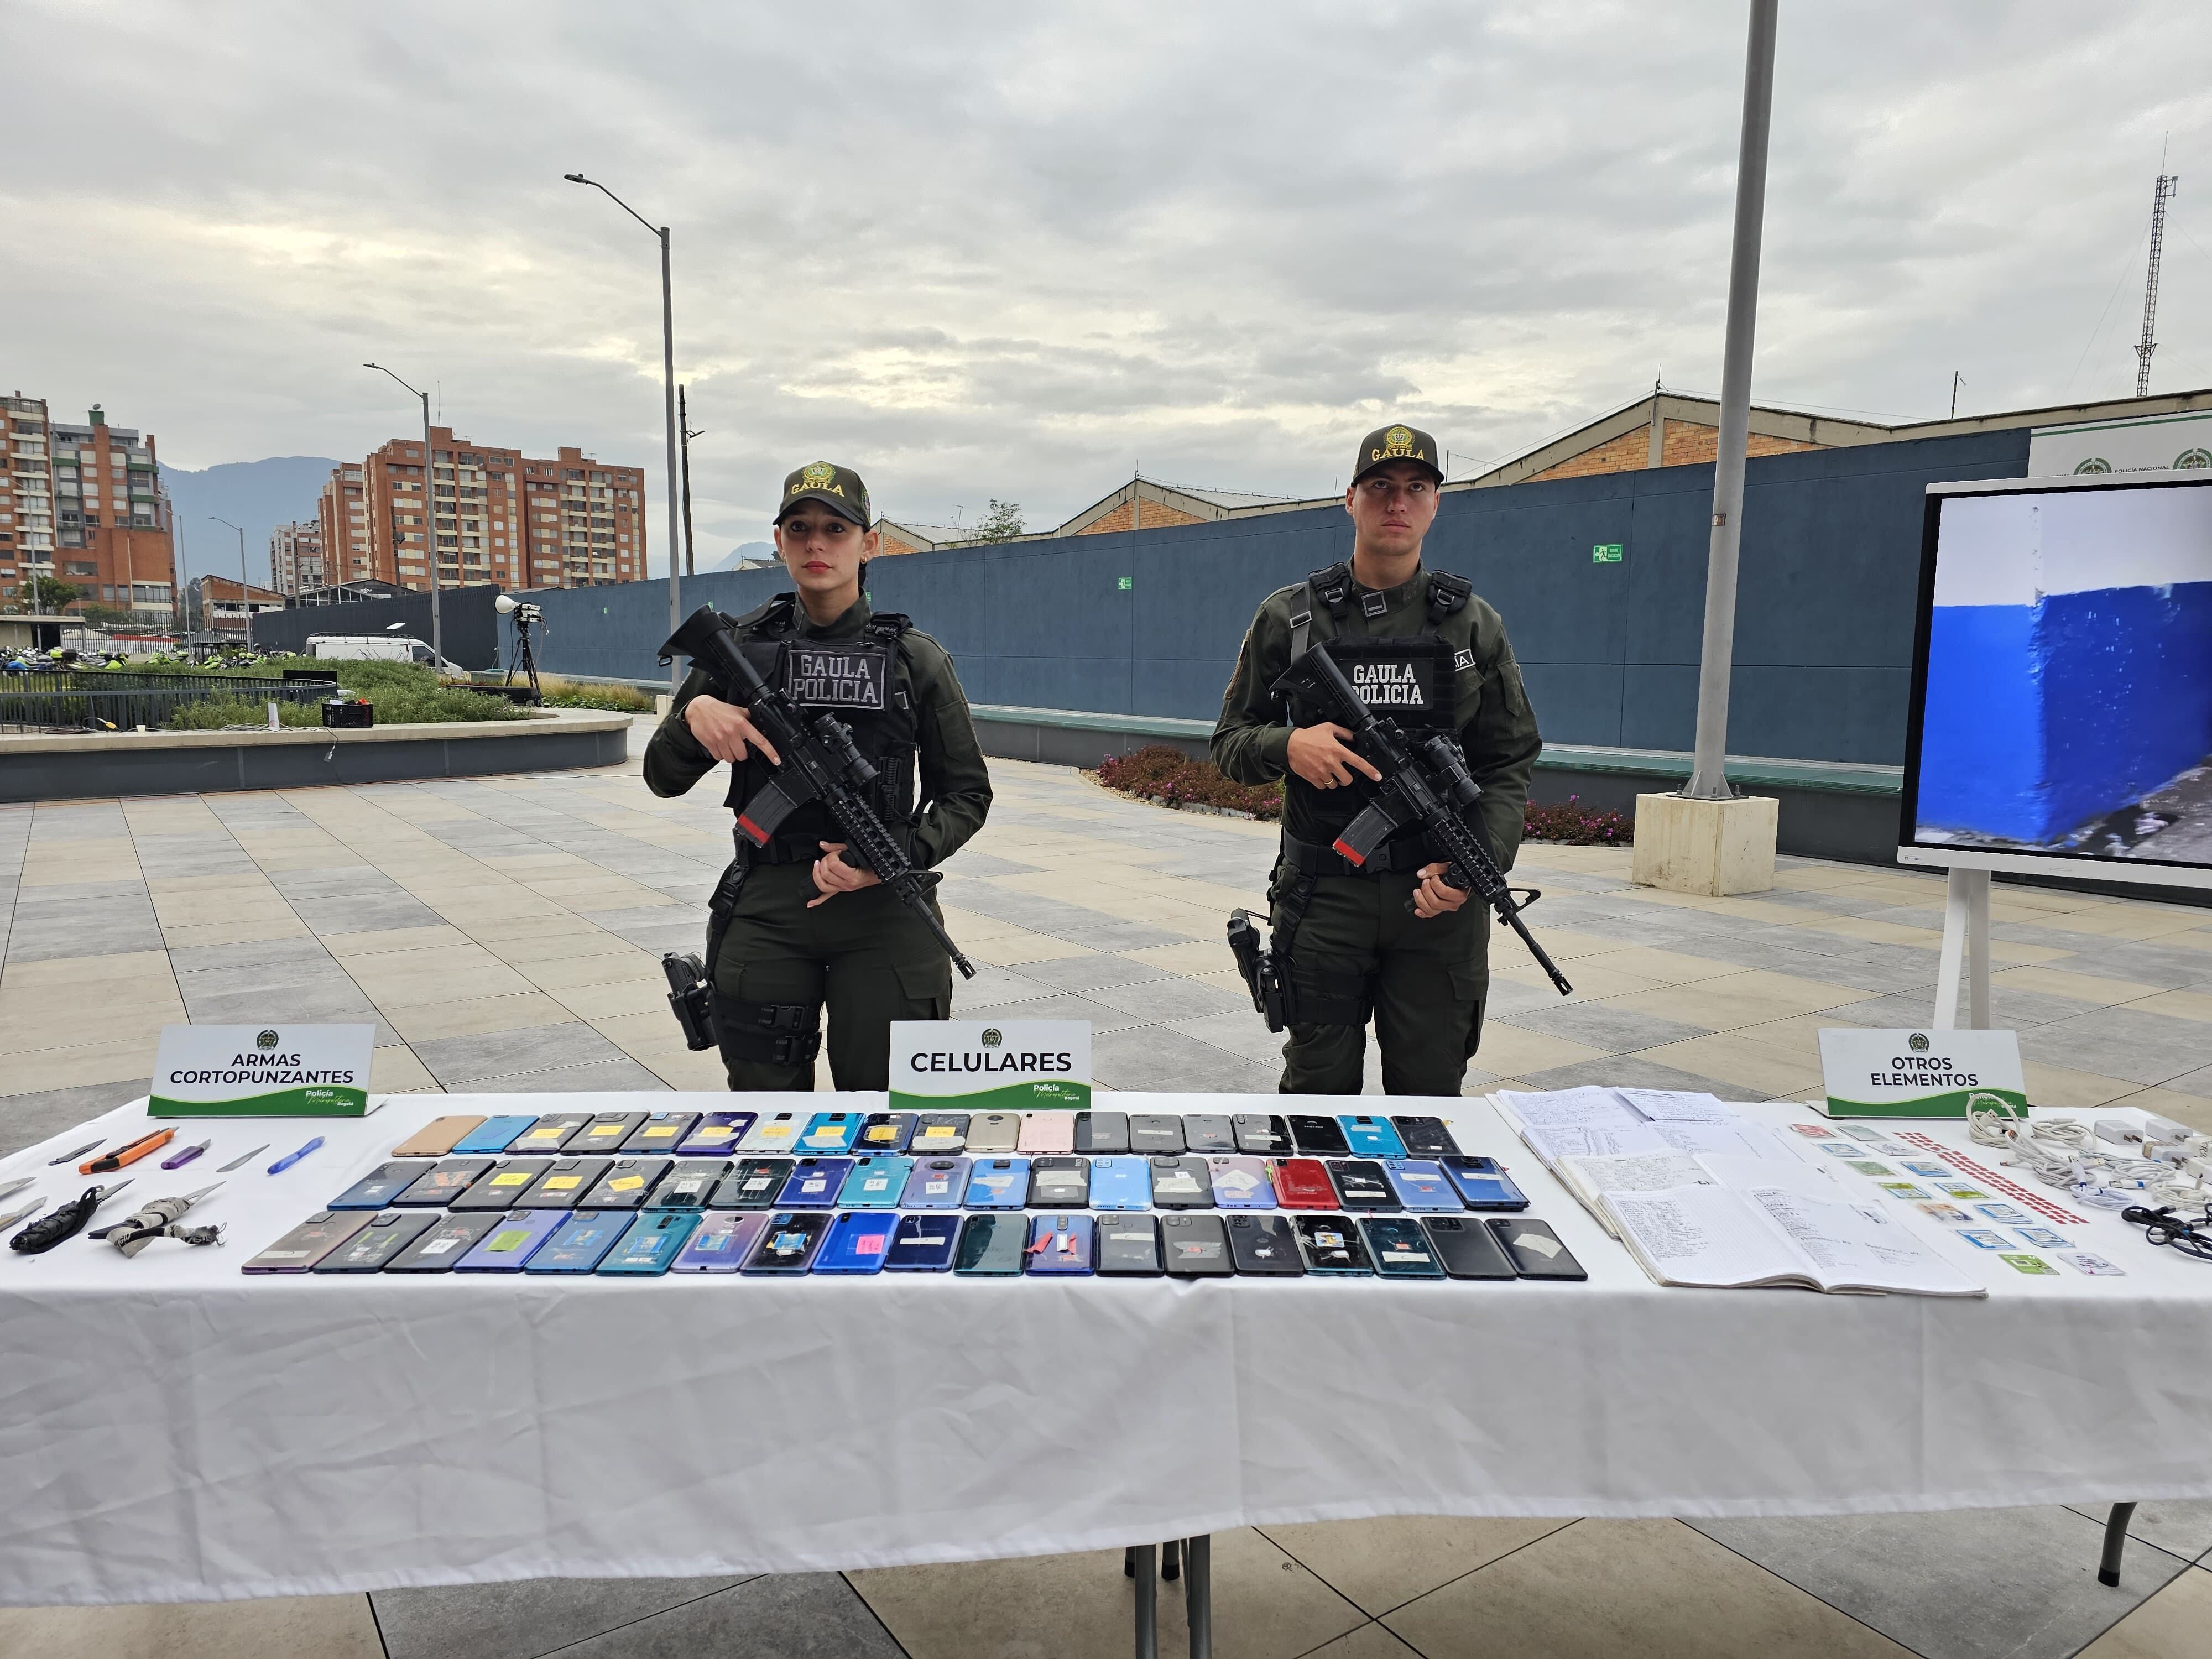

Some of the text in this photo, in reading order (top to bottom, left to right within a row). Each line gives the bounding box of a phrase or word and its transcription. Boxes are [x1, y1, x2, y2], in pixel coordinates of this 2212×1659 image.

[1371, 448, 1425, 461] GAULA
[791, 482, 845, 497] GAULA
[801, 655, 870, 680] GAULA
[1353, 664, 1416, 684] GAULA
[792, 679, 878, 704] POLICIA
[231, 1053, 301, 1067] ARMAS
[911, 1052, 1072, 1072] CELULARES
[1891, 1057, 1953, 1070] OTROS
[170, 1070, 354, 1084] CORTOPUNZANTES
[1870, 1073, 1979, 1087] ELEMENTOS
